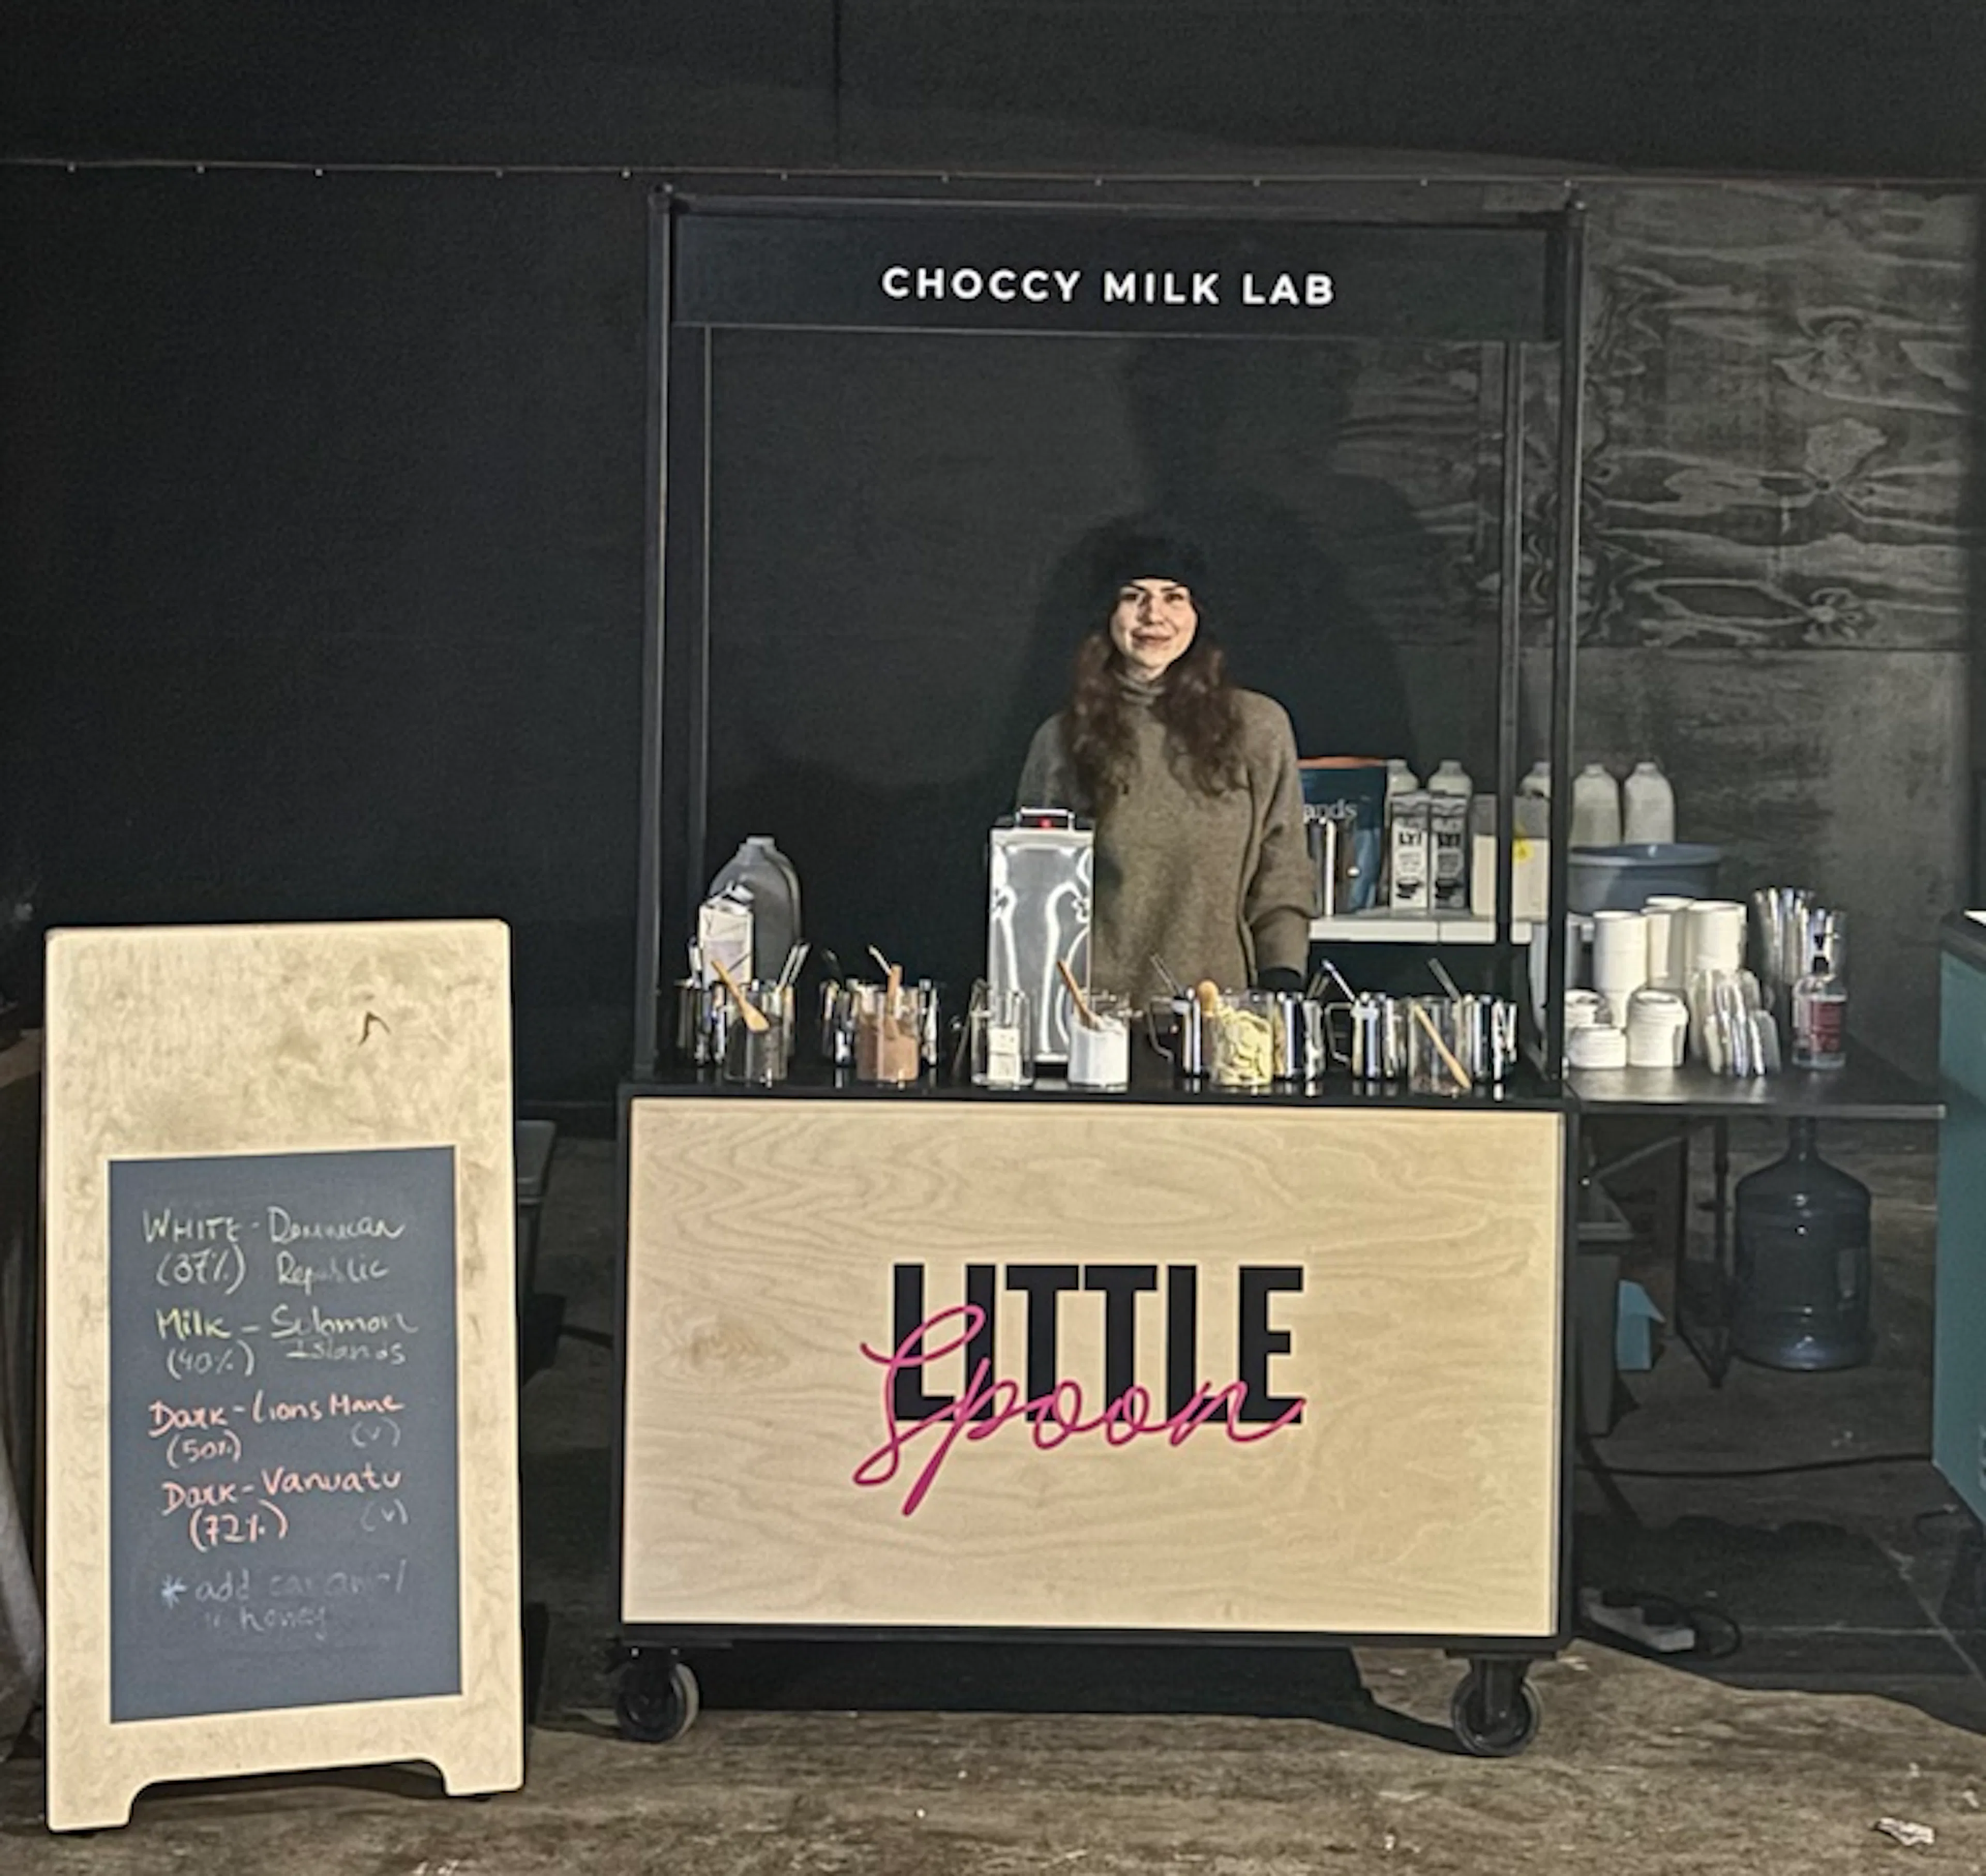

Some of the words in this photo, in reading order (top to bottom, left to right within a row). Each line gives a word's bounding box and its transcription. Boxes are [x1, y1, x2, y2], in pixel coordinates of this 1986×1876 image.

[881, 267, 1081, 302] CHOCCY
[1103, 270, 1221, 304] MILK
[1242, 273, 1335, 306] LAB
[167, 1339, 254, 1380] (40%)
[894, 1264, 1304, 1423] LITTLE
[852, 1304, 1307, 1517] Spoon
